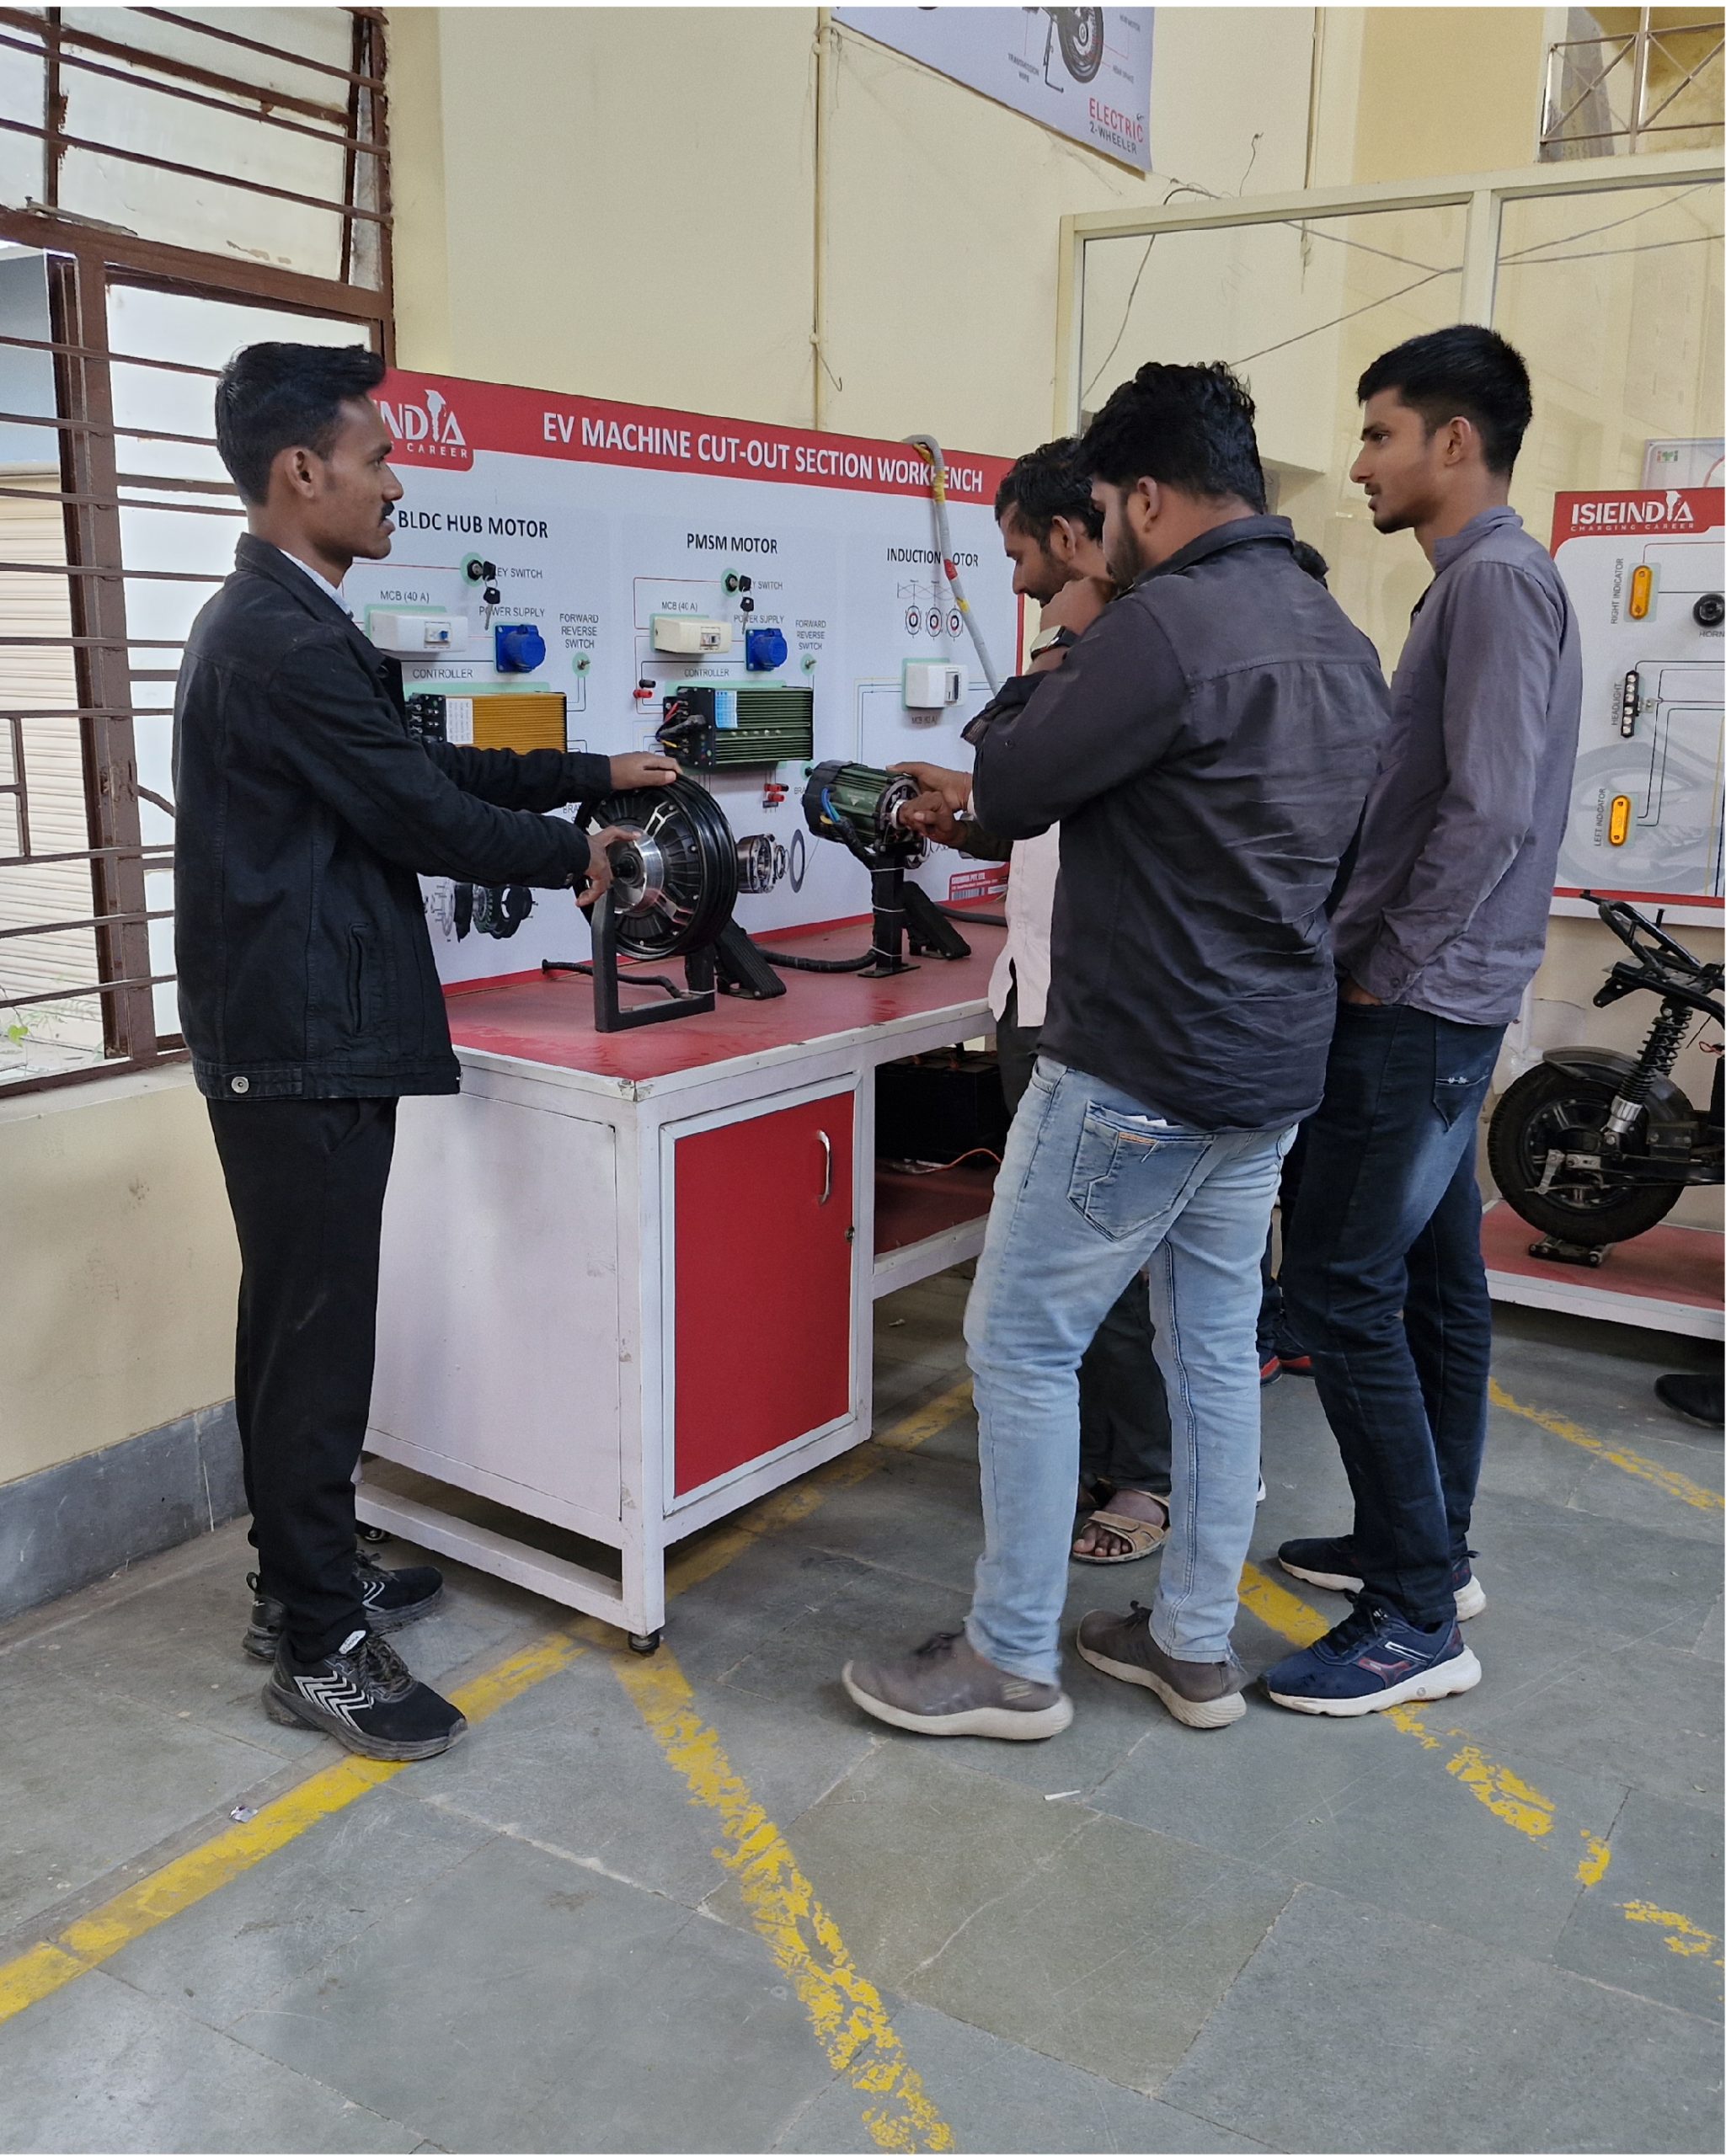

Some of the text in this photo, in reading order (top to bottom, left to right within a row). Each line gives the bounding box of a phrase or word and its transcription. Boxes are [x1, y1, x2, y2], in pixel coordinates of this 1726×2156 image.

[1089, 97, 1144, 143] ELECTRIC
[1089, 120, 1137, 155] 2-WHEELER
[407, 442, 468, 459] CAREER
[543, 412, 574, 444] EV
[581, 417, 692, 459] MACHINE
[697, 433, 790, 470] CUT-OUT
[795, 446, 873, 480] SECTION
[1571, 491, 1694, 526] ISIEINDIA
[398, 510, 548, 539] BLDC HUB MOTOR
[687, 532, 778, 554] PMSM MOTOR
[887, 547, 979, 567] INDUCTION OTOR
[510, 568, 543, 579] SWITCH
[757, 581, 783, 590] SWITCH
[1611, 558, 1624, 624] RIGHT INDICATOR
[380, 590, 430, 603] MCB (40 A)
[513, 606, 545, 617] SUPPLY
[661, 601, 677, 611] MCB
[559, 613, 599, 624] FORWARD
[760, 615, 784, 624] SUPPLY
[795, 619, 826, 628] FORWARD
[561, 626, 597, 637] REVERSE
[797, 631, 825, 640] REVERSE
[565, 638, 595, 649] SWITCH
[798, 642, 822, 651] SWITCH
[413, 669, 473, 679] CONTROLLER
[684, 668, 729, 678] CONTROLLER
[1611, 683, 1623, 726] HEADLIGHT
[1594, 788, 1606, 846] LEFT INDICATOR
